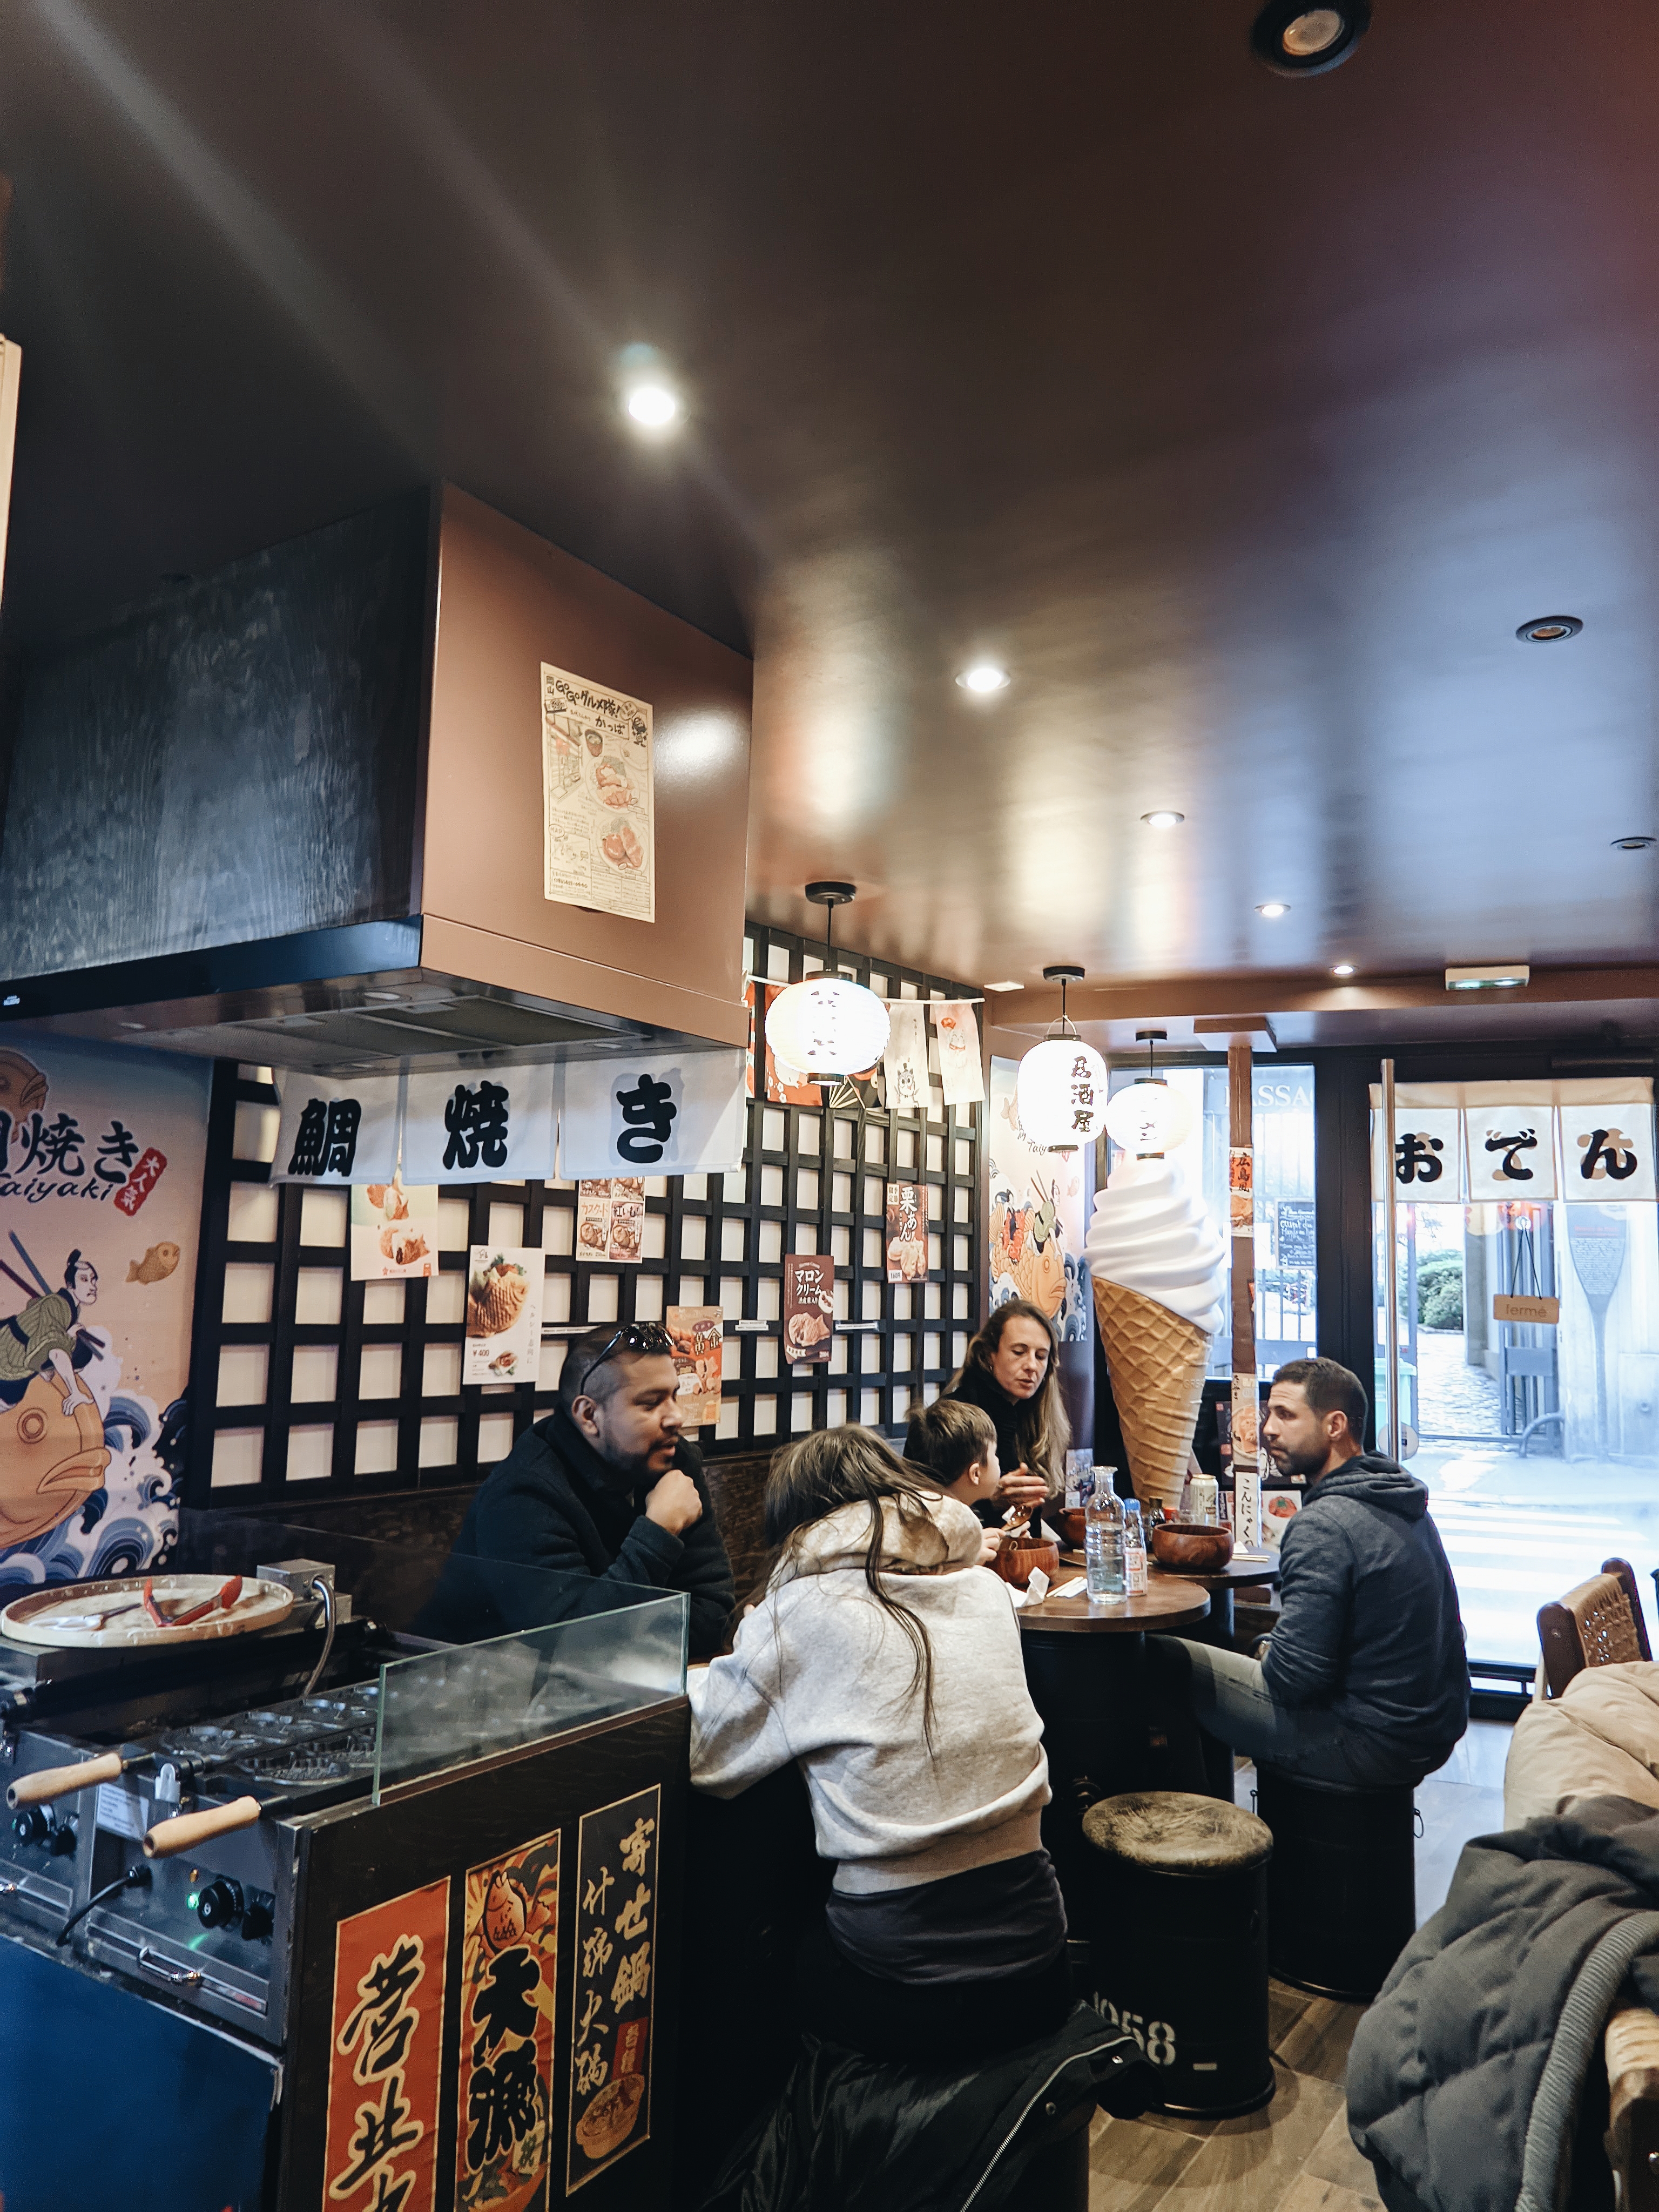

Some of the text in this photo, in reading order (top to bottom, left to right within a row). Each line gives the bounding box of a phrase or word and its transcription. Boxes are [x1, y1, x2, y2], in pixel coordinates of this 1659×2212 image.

[1071, 1056, 1094, 1132] 居酒屋
[1225, 1085, 1315, 1108] SSA
[0, 1110, 139, 1184] 焼き
[1027, 1138, 1047, 1156] Taiy
[1395, 1128, 1637, 1184] おでん
[795, 1270, 824, 1284] マロン
[797, 1283, 822, 1296] クリーム
